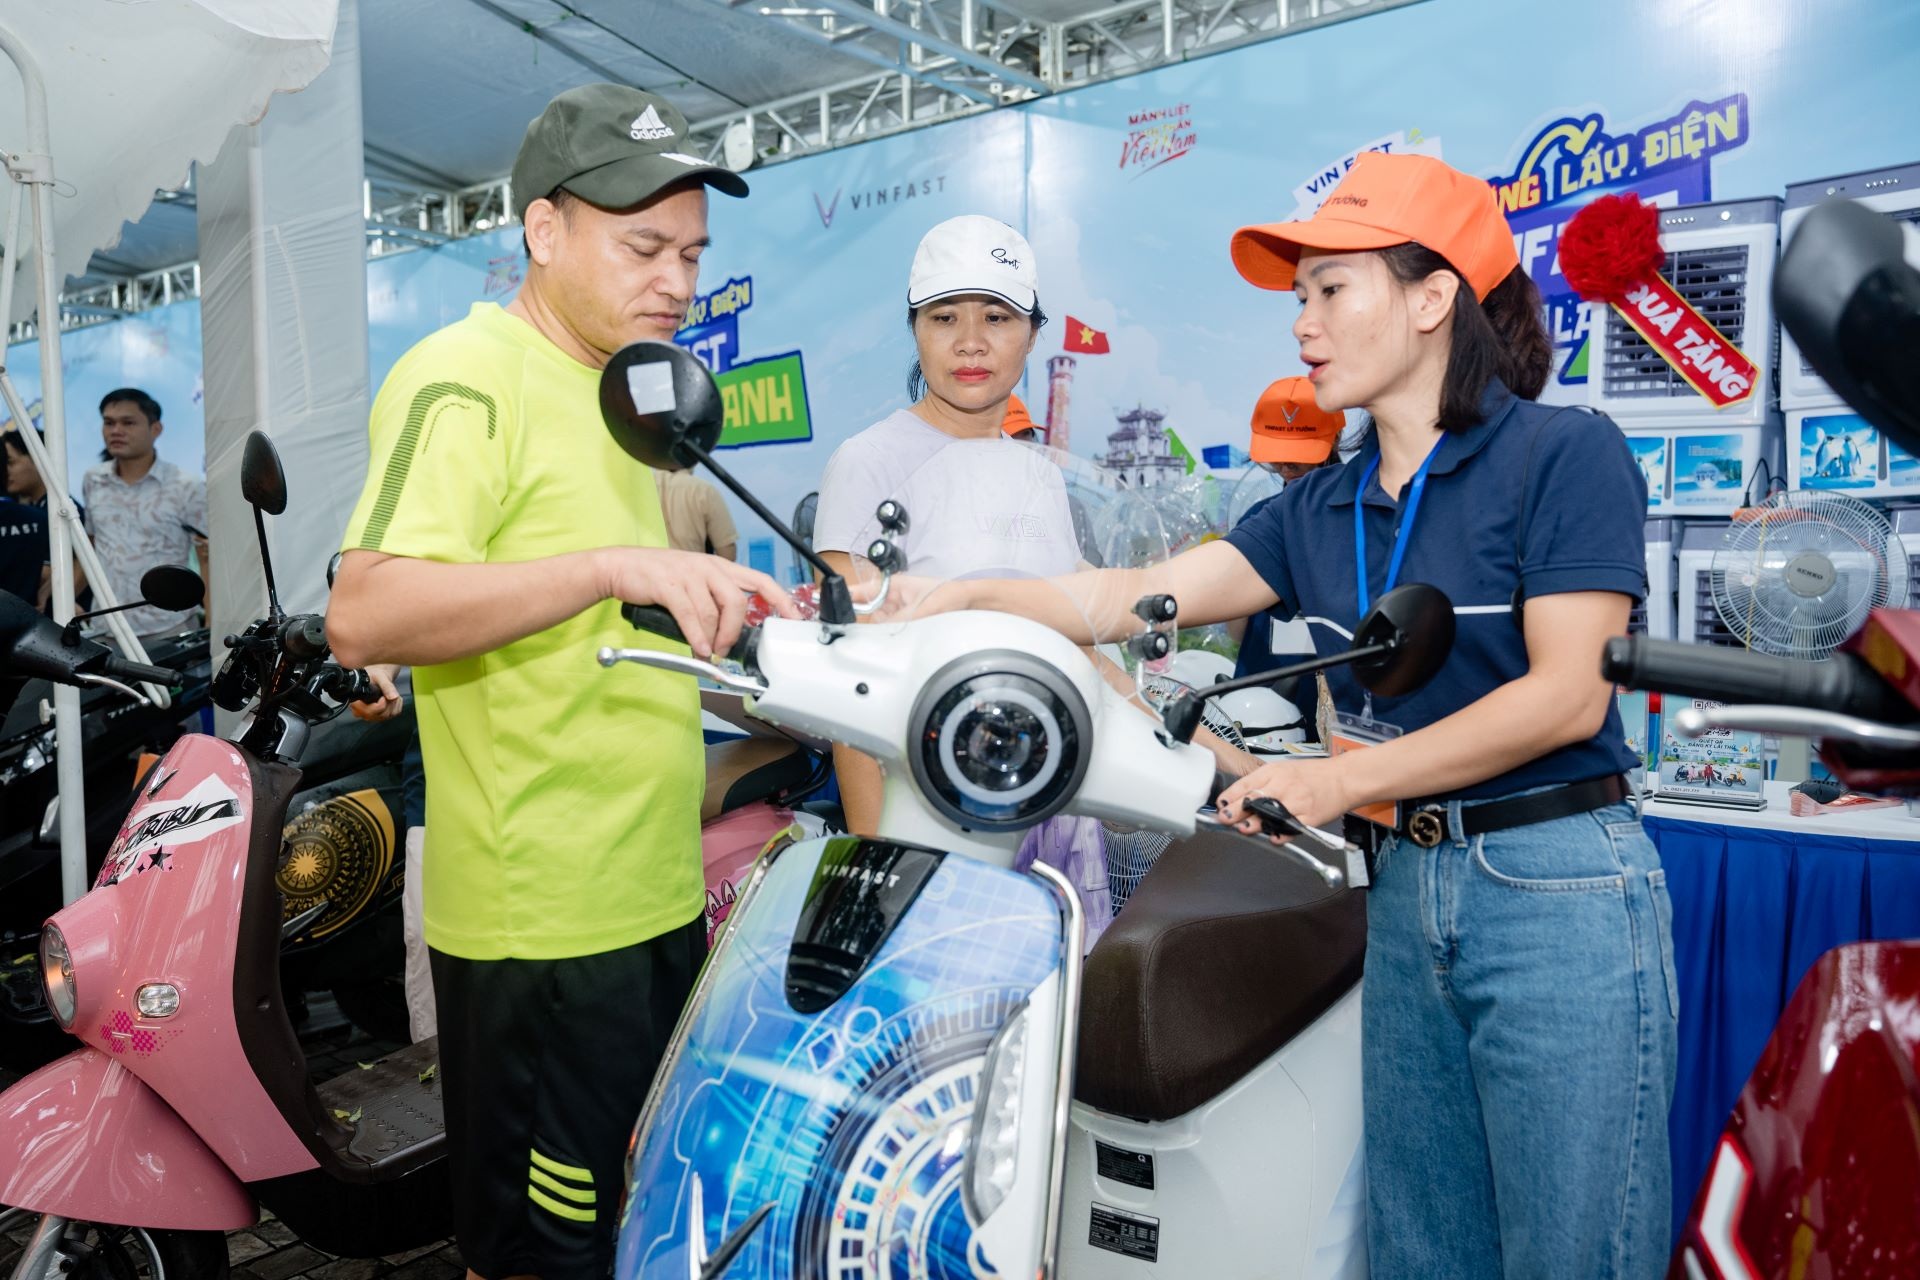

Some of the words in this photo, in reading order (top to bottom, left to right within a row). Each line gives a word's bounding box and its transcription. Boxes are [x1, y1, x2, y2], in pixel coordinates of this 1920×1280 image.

[630, 127, 675, 140] adidas
[1306, 167, 1340, 194] VIN
[1561, 141, 1629, 195] LẤY
[850, 176, 946, 211] VINFAST
[1673, 327, 1750, 398] TẶNG
[822, 864, 900, 888] VINFAST
